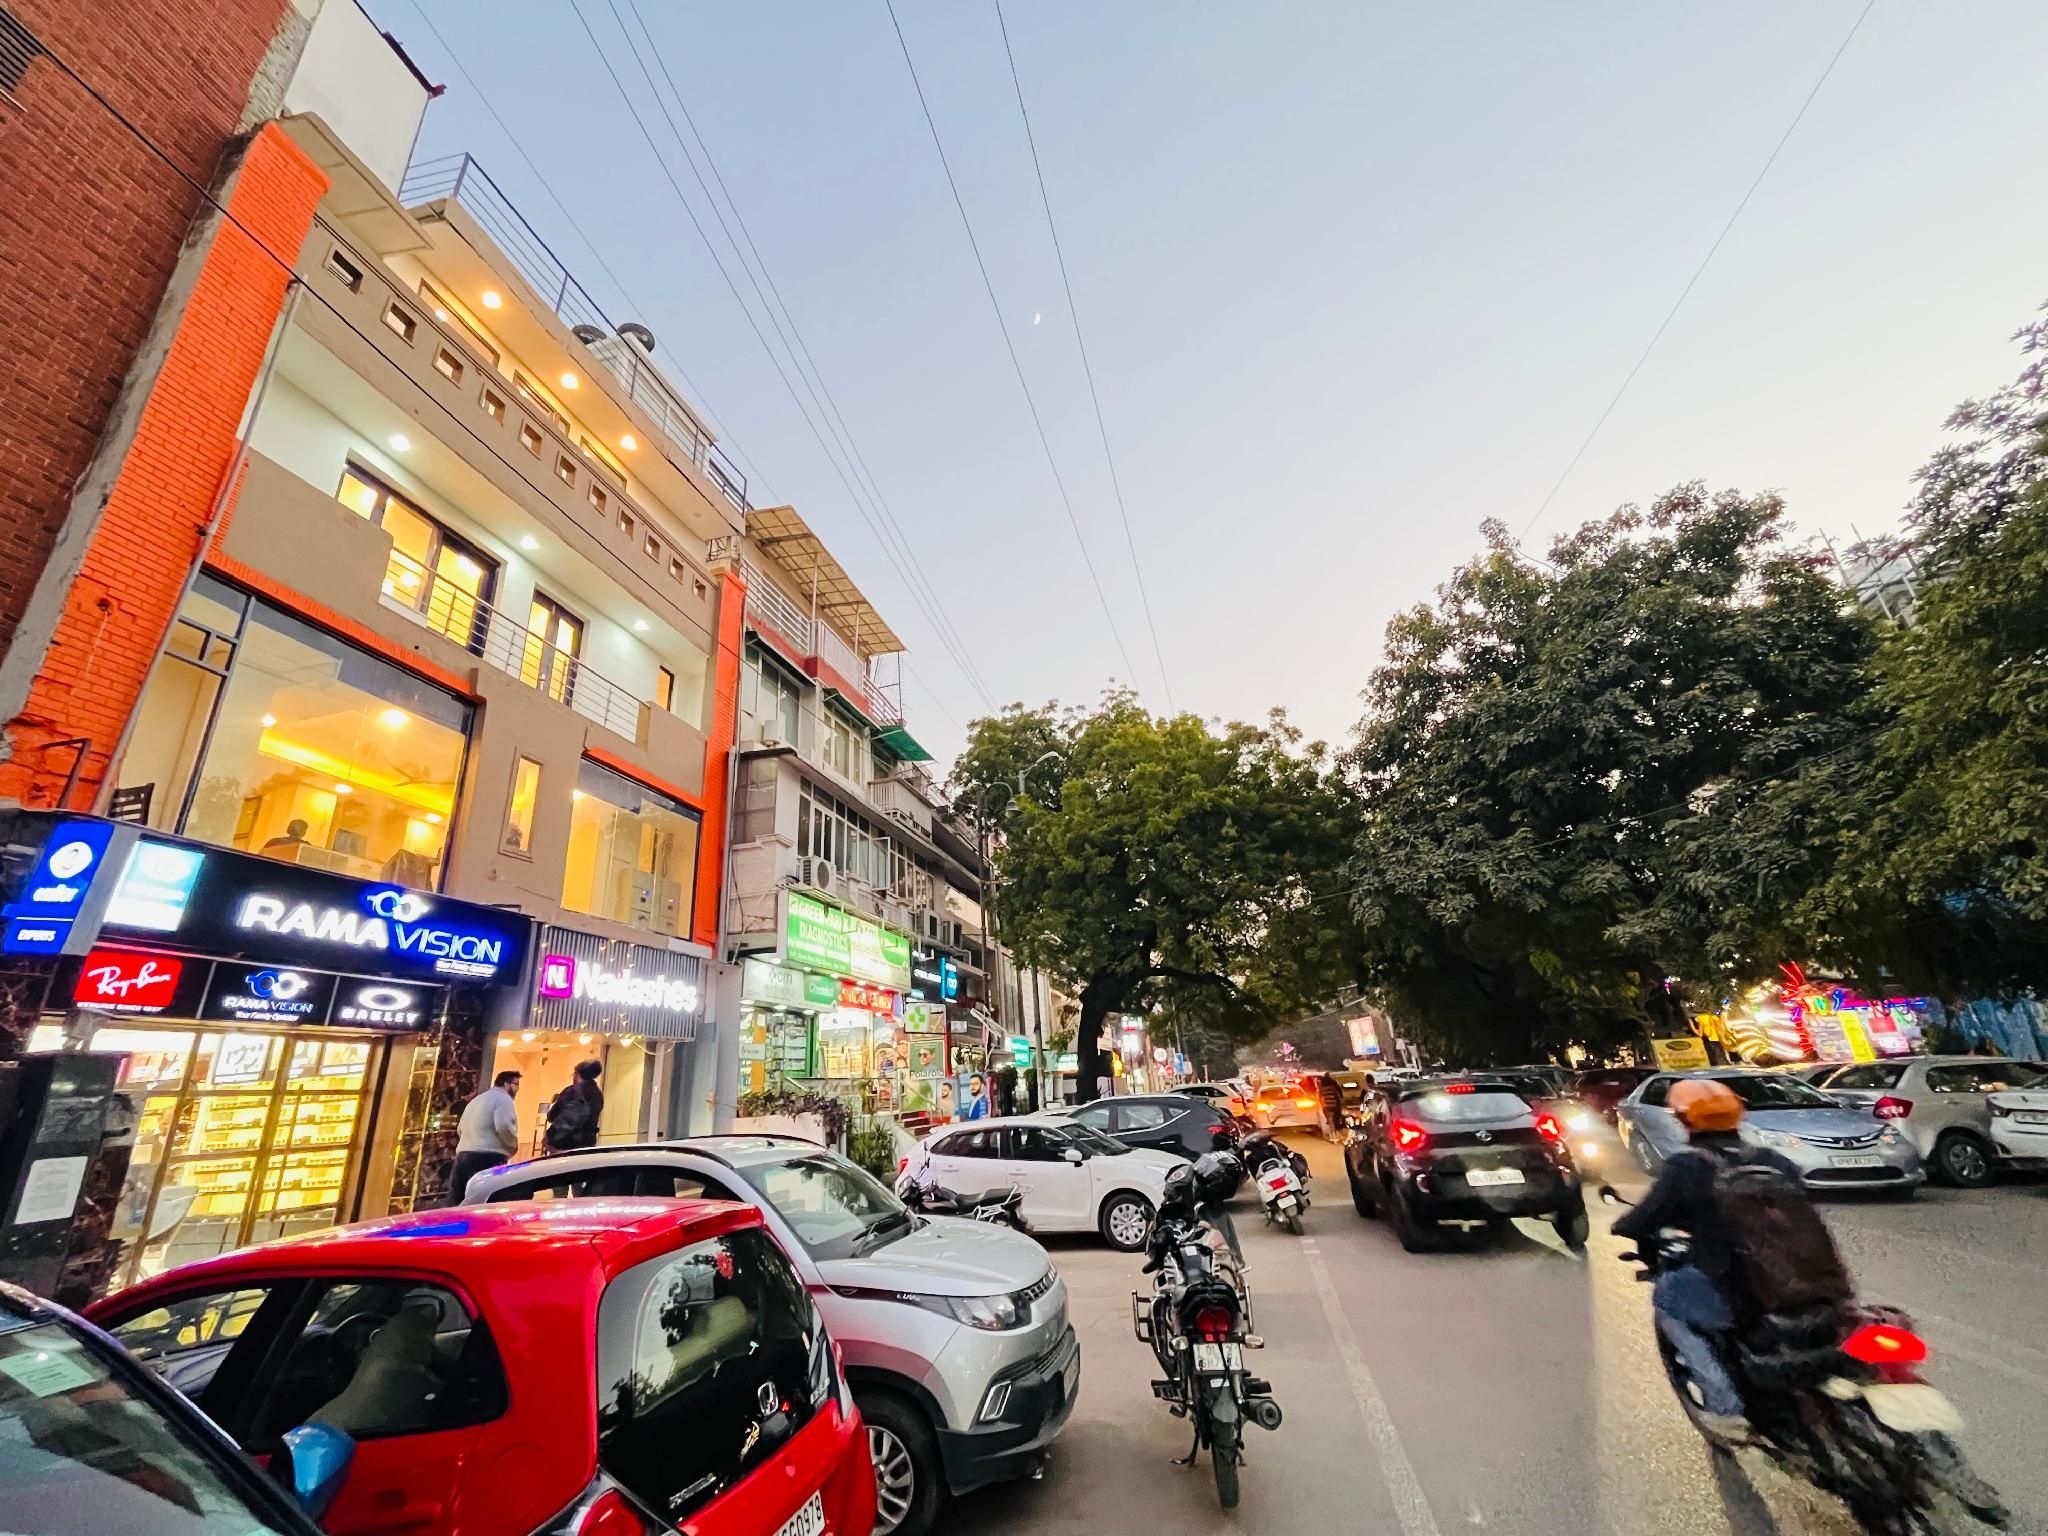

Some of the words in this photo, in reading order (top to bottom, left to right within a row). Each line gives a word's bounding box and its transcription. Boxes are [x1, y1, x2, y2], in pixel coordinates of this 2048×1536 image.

[239, 897, 389, 949] RAMA
[395, 923, 502, 963] VISION
[799, 921, 848, 954] DIAGNOSTICS
[88, 962, 171, 997] Ray-Ban
[223, 996, 268, 1011] RAMA
[271, 1001, 314, 1014] VISION
